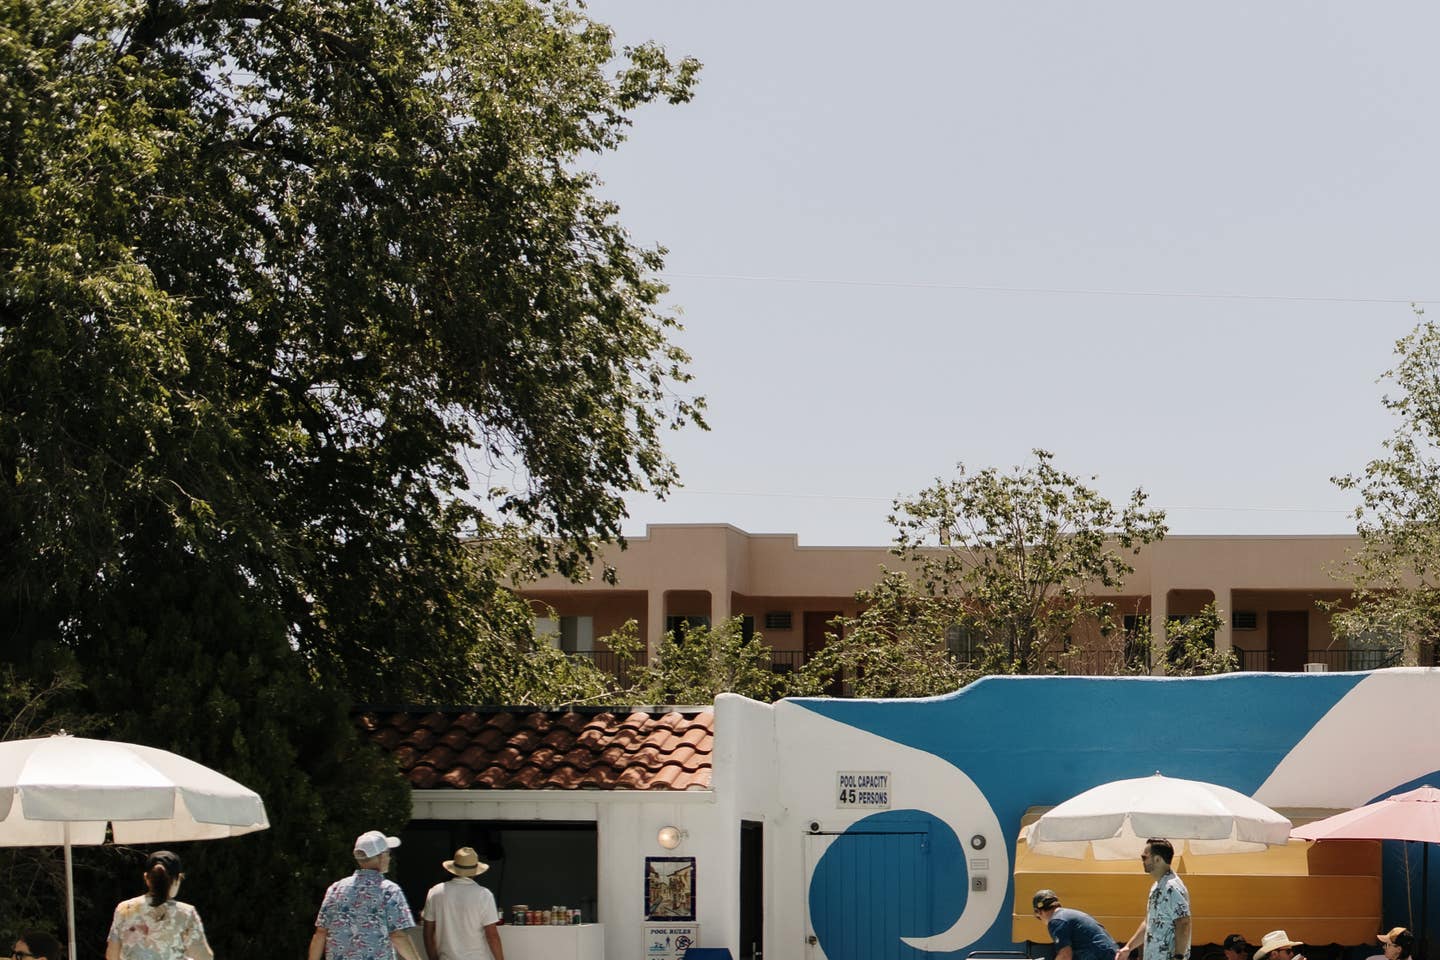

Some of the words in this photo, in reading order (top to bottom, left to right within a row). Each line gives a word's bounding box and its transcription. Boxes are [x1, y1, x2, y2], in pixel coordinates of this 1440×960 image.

[840, 775, 856, 788] POOL
[858, 775, 888, 788] CAPACITY
[839, 789, 856, 804] 45
[858, 791, 888, 804] PERSONS
